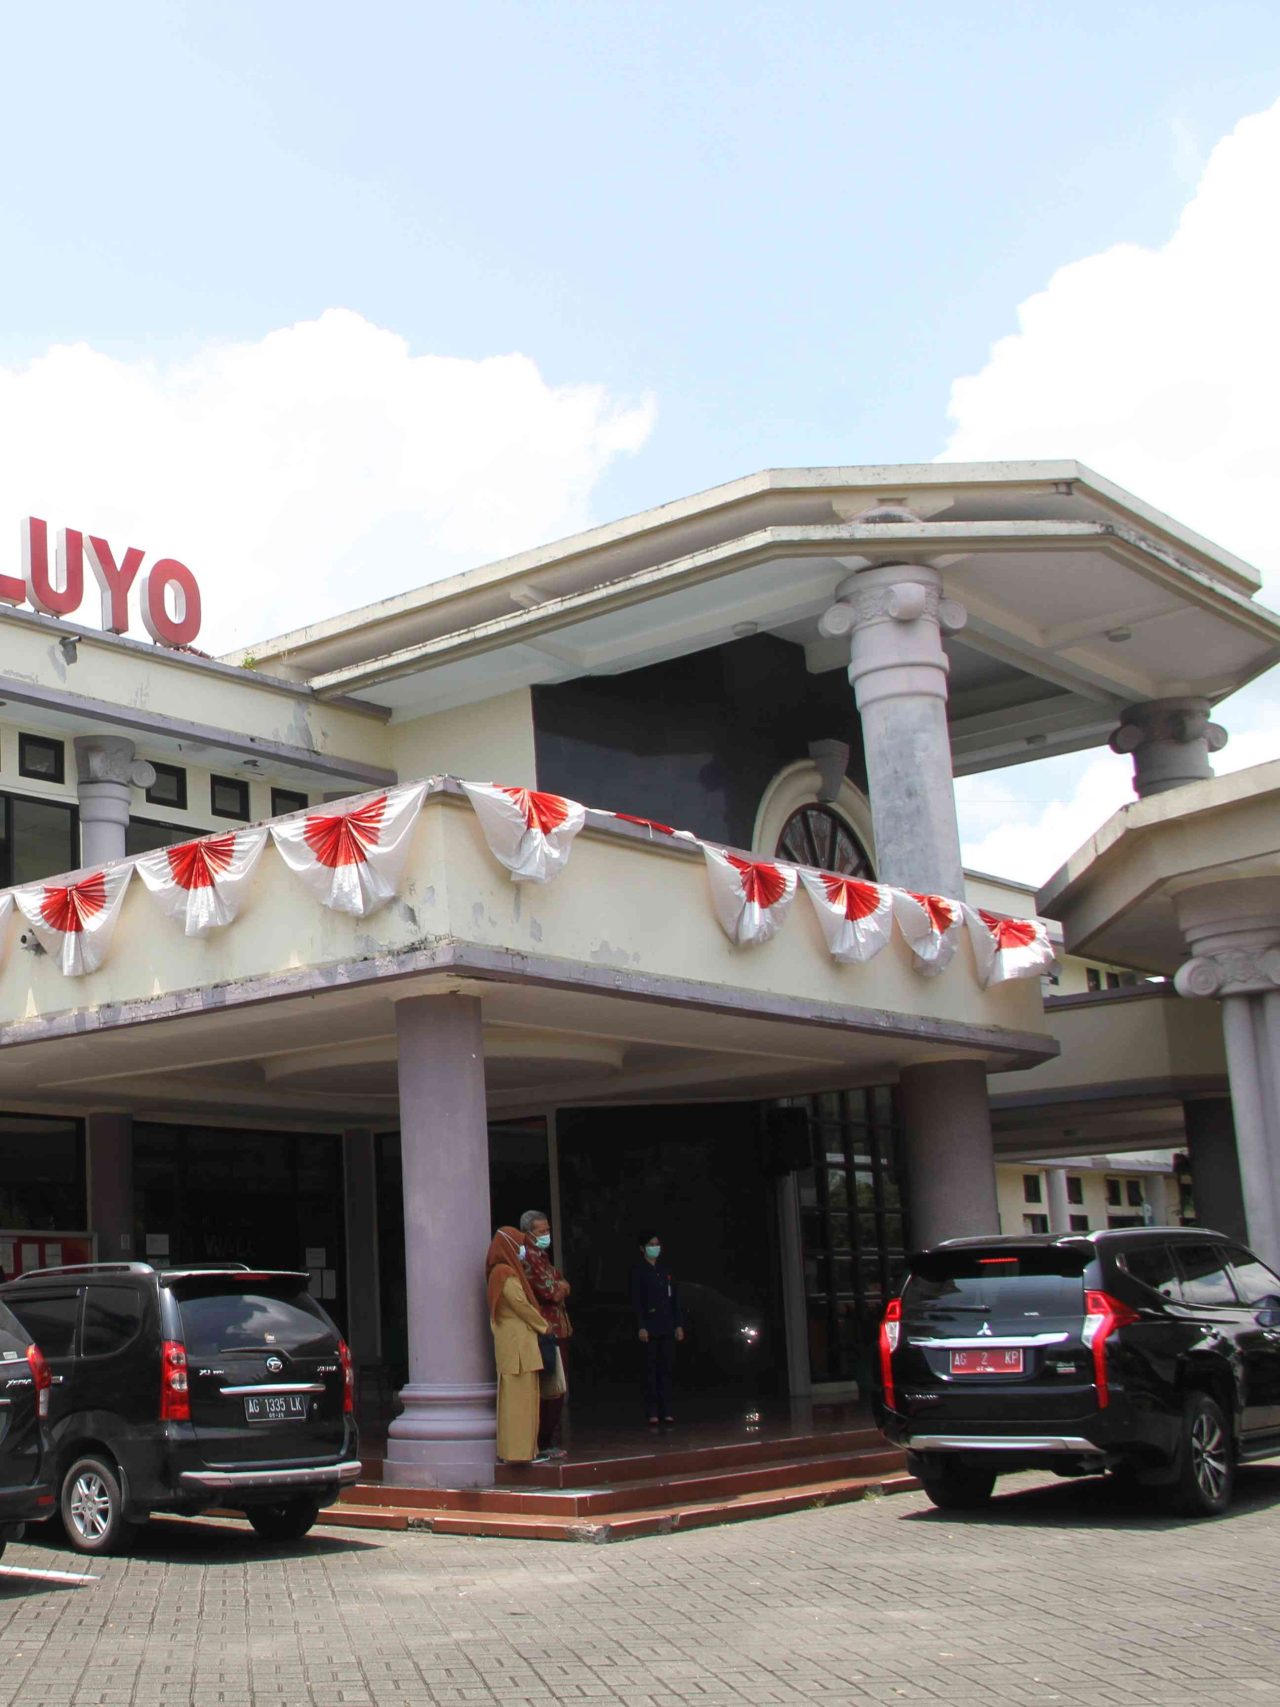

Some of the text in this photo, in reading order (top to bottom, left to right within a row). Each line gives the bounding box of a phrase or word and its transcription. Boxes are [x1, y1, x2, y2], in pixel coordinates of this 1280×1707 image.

[954, 1350, 1019, 1366] AG 2 KP
[248, 1396, 302, 1413] AG 1335 LK
